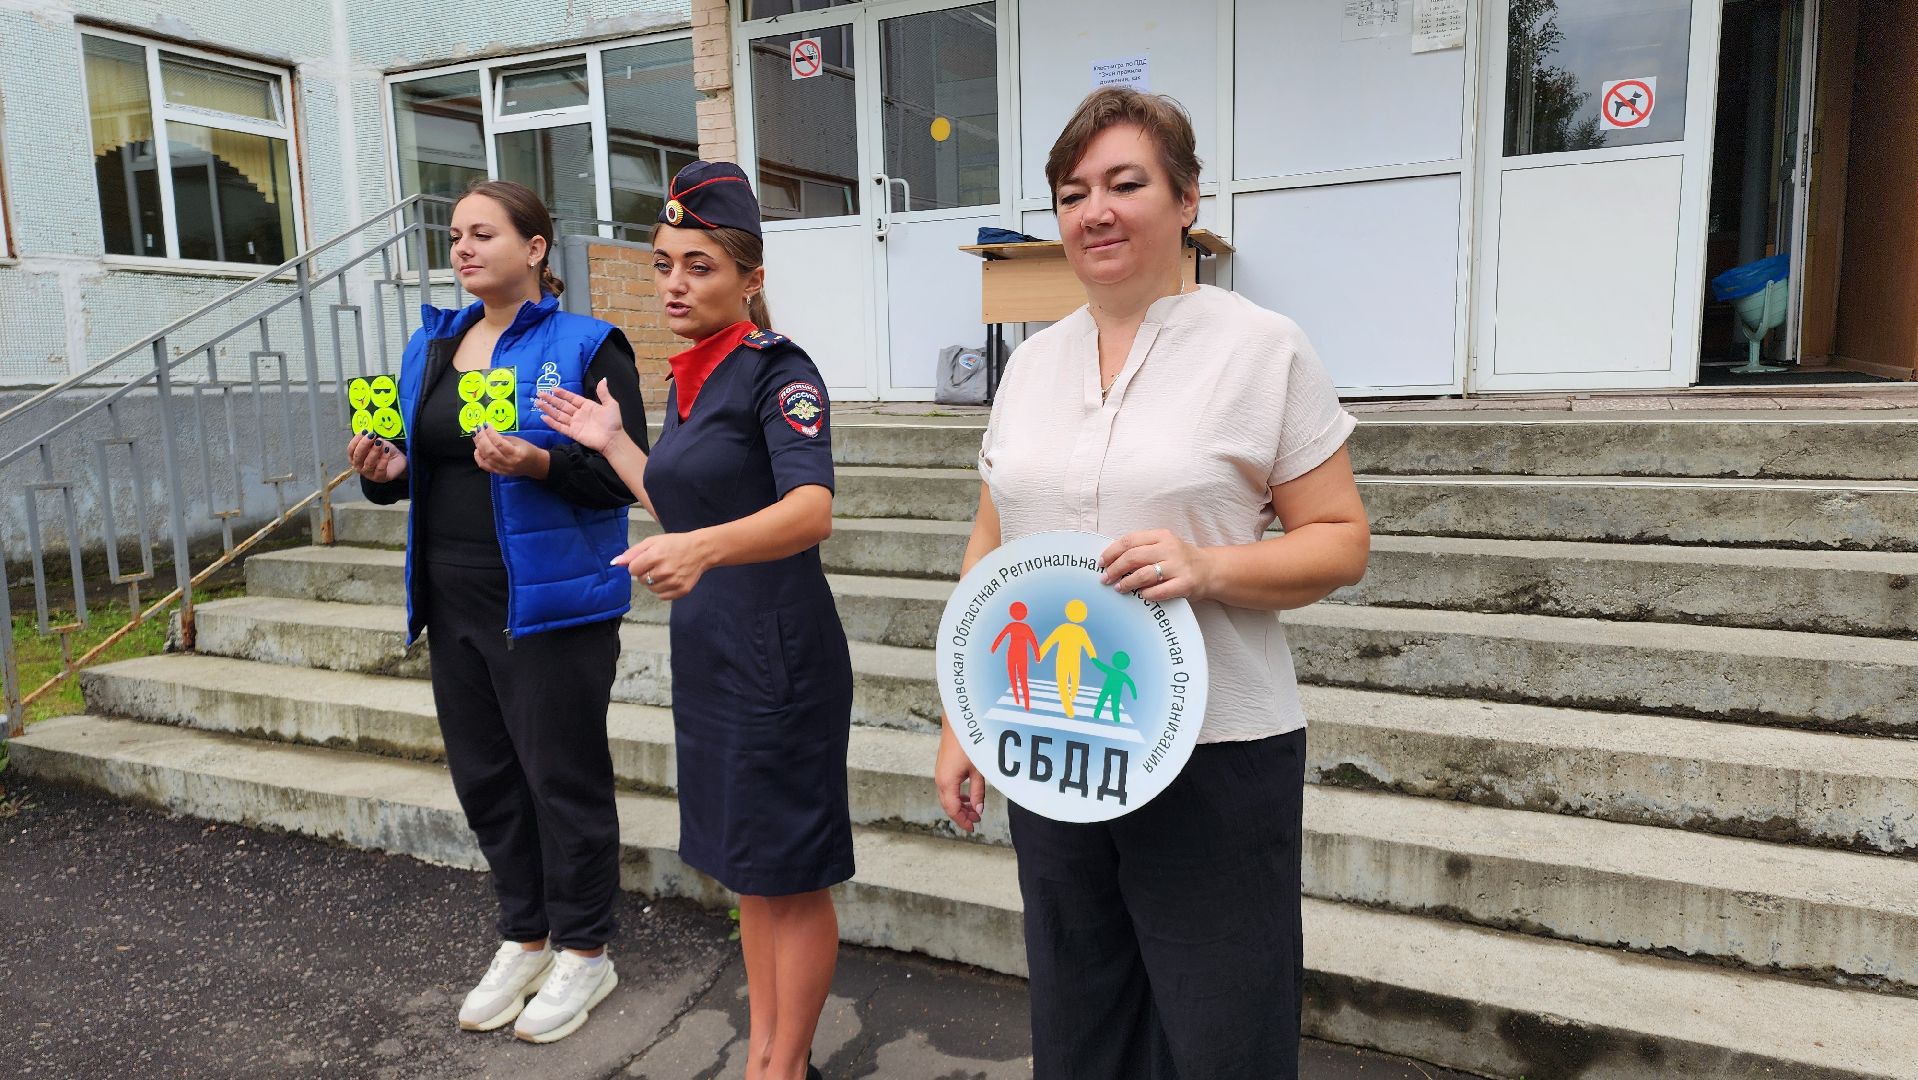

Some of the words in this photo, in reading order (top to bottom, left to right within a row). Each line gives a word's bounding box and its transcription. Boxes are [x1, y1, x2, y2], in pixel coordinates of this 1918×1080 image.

[952, 579, 1001, 647] Областная
[953, 651, 985, 746] Московская
[1142, 671, 1190, 775] Организация
[997, 729, 1129, 807] СБДД
